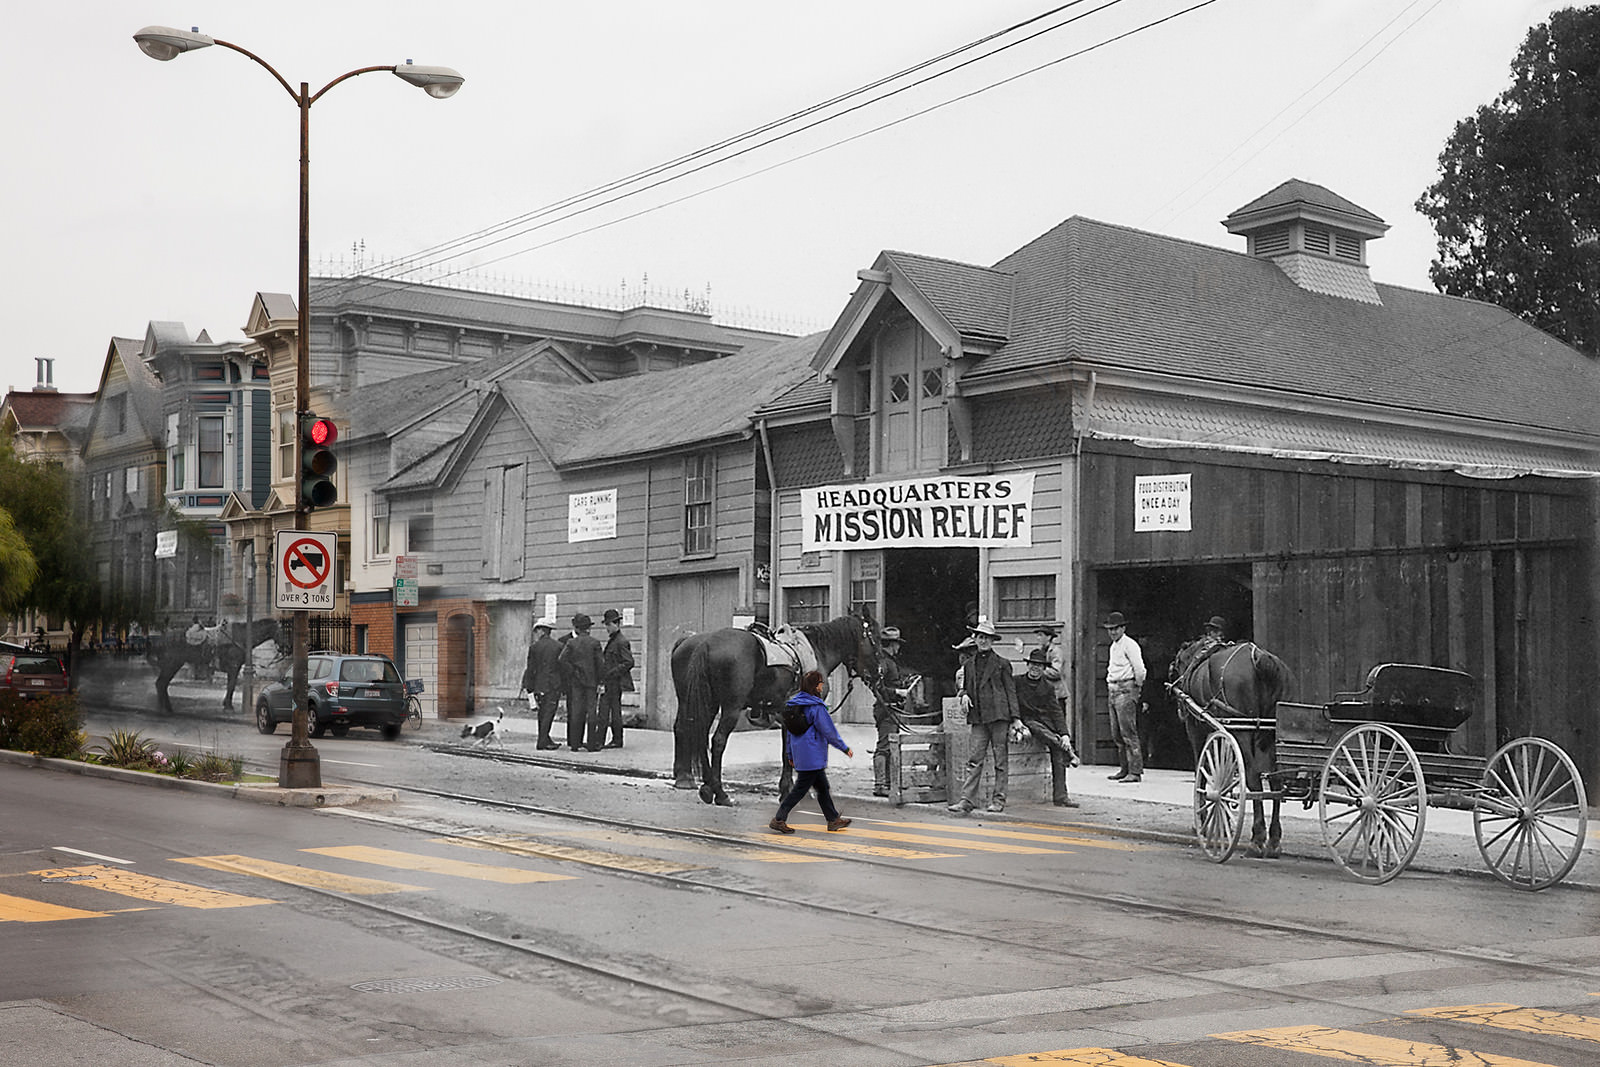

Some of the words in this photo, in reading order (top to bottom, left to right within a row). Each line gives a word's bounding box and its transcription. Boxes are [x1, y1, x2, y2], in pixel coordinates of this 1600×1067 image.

[1139, 483, 1152, 494] FOOD
[1153, 481, 1188, 493] DISTRIBUTION
[817, 480, 1012, 509] HEADQUARTERS
[1142, 498, 1159, 509] ONCE
[1161, 498, 1167, 508] A
[1168, 497, 1180, 508] DAY
[814, 508, 924, 543] MISSION
[930, 502, 1028, 539] RELIEF
[1141, 515, 1150, 523] AT
[280, 593, 300, 602] OVER
[302, 592, 309, 605] 3
[312, 594, 330, 603] TONS
